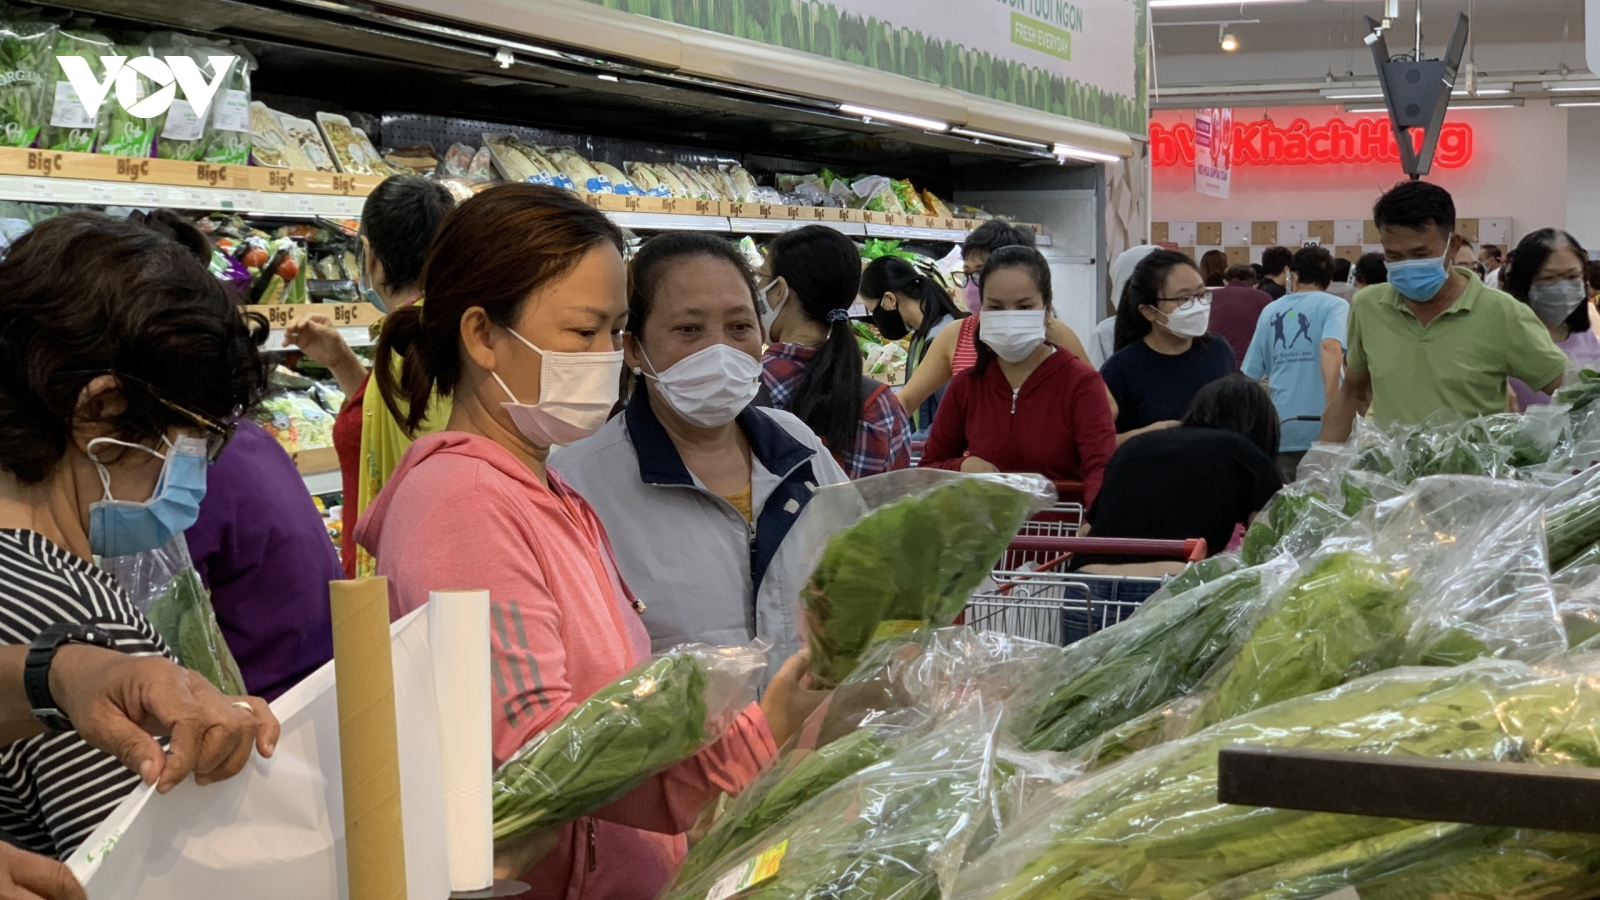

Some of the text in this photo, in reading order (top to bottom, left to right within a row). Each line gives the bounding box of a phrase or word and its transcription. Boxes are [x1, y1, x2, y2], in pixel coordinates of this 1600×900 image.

[1014, 21, 1069, 54] FRESH EVERYDAY
[1359, 121, 1470, 165] Hg
